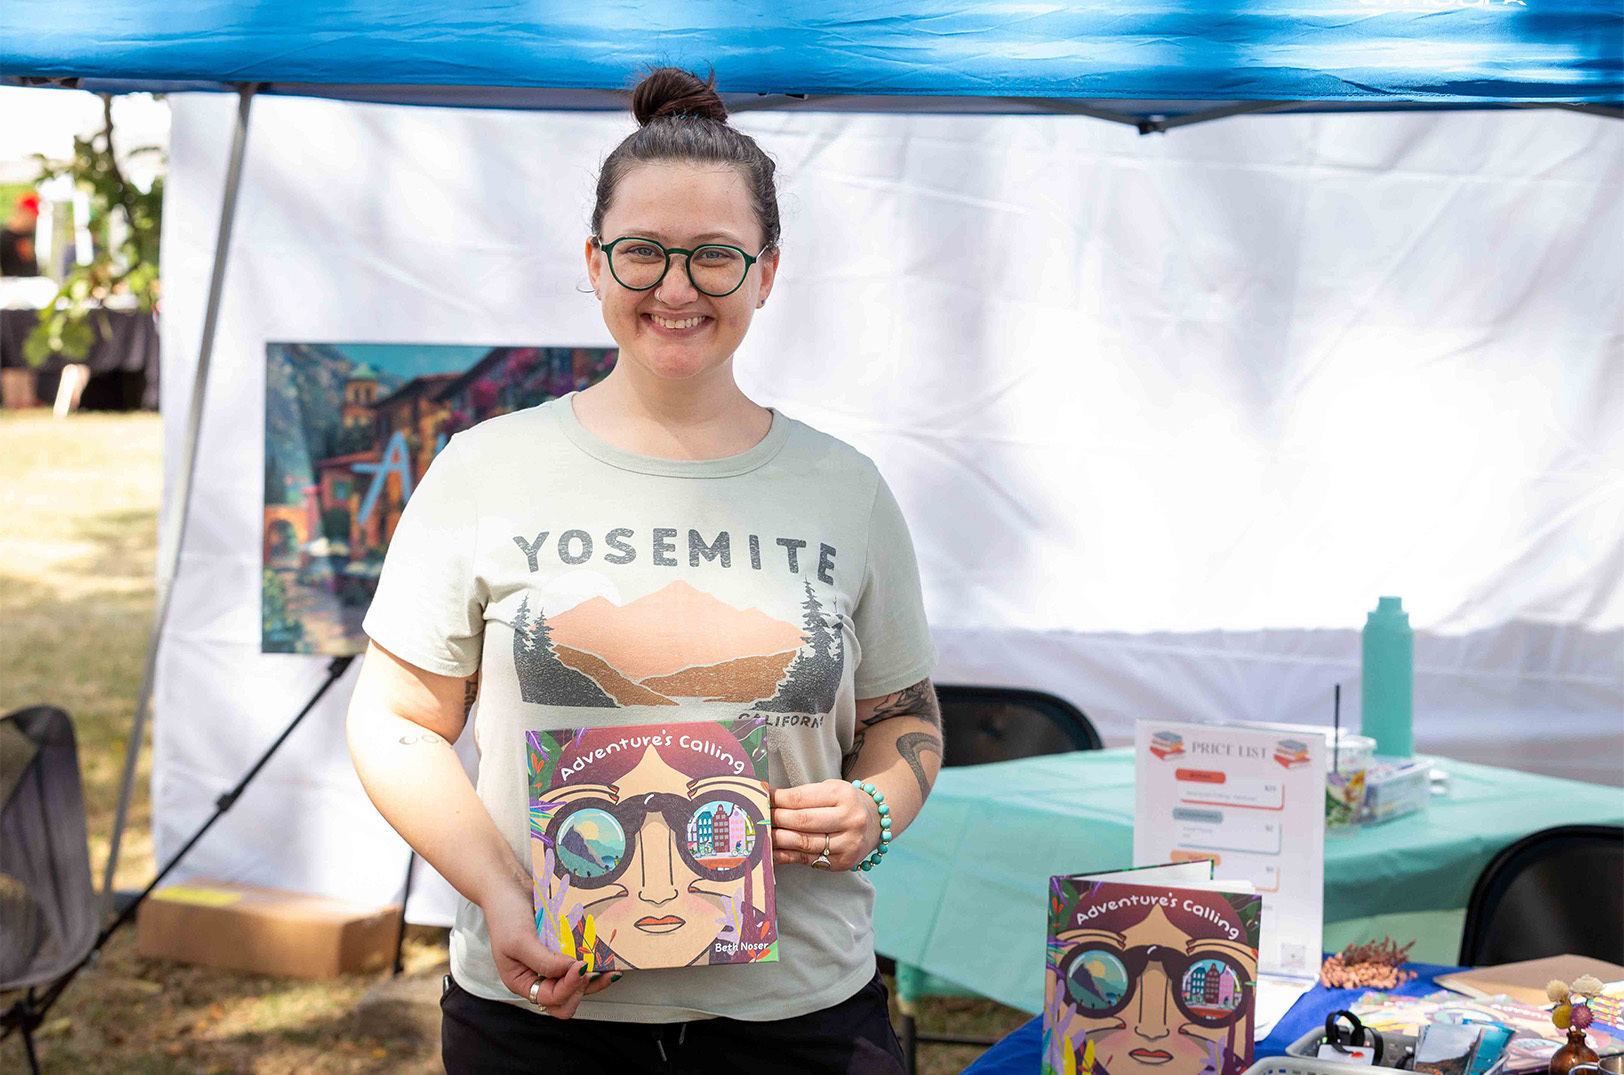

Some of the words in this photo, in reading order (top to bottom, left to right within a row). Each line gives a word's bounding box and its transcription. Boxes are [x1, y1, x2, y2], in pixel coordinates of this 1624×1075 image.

[512, 527, 837, 586] YOSEMITE
[560, 729, 673, 781] Adventure's
[679, 735, 745, 775] Calling
[1191, 741, 1233, 756] PRICE
[1238, 744, 1267, 759] LIST
[1076, 892, 1178, 926] Adventure's
[1183, 899, 1240, 940] Calling
[715, 942, 738, 953] Beth
[740, 942, 769, 951] Noser
